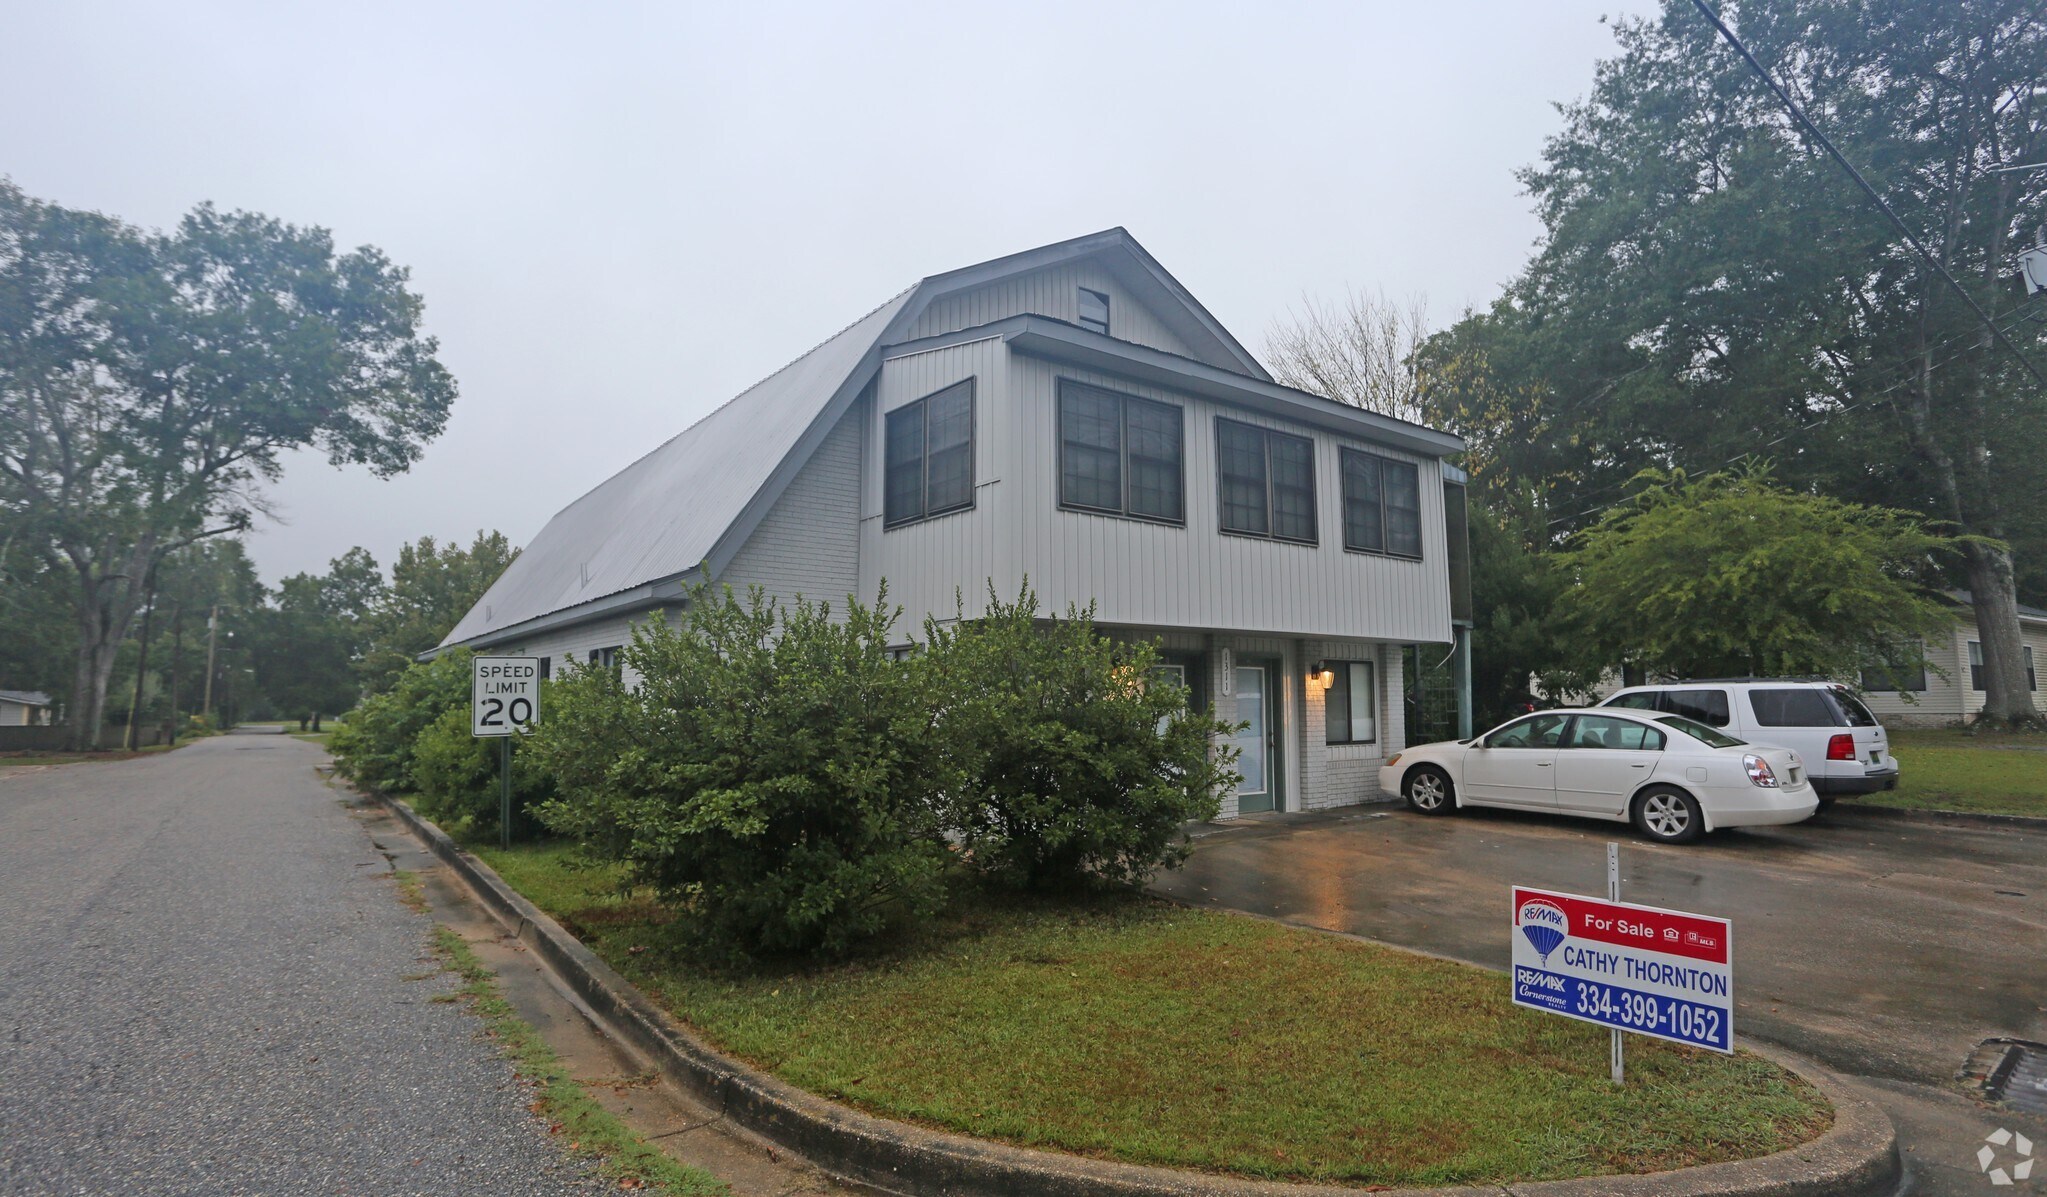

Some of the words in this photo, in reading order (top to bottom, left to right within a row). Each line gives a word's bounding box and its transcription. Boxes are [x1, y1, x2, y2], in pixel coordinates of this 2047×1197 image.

[480, 666, 534, 678] SPEED
[485, 682, 528, 694] LIMIT
[480, 697, 533, 727] 20
[1524, 907, 1563, 927] RE/MAX
[1585, 913, 1613, 931] For
[1617, 919, 1655, 938] Sale
[1517, 968, 1566, 993] RE/MAX
[1564, 945, 1619, 975] CATHY
[1624, 957, 1727, 997] THORNTON
[1519, 984, 1567, 1006] Cornerstone
[1576, 982, 1720, 1044] 334-399-1052
